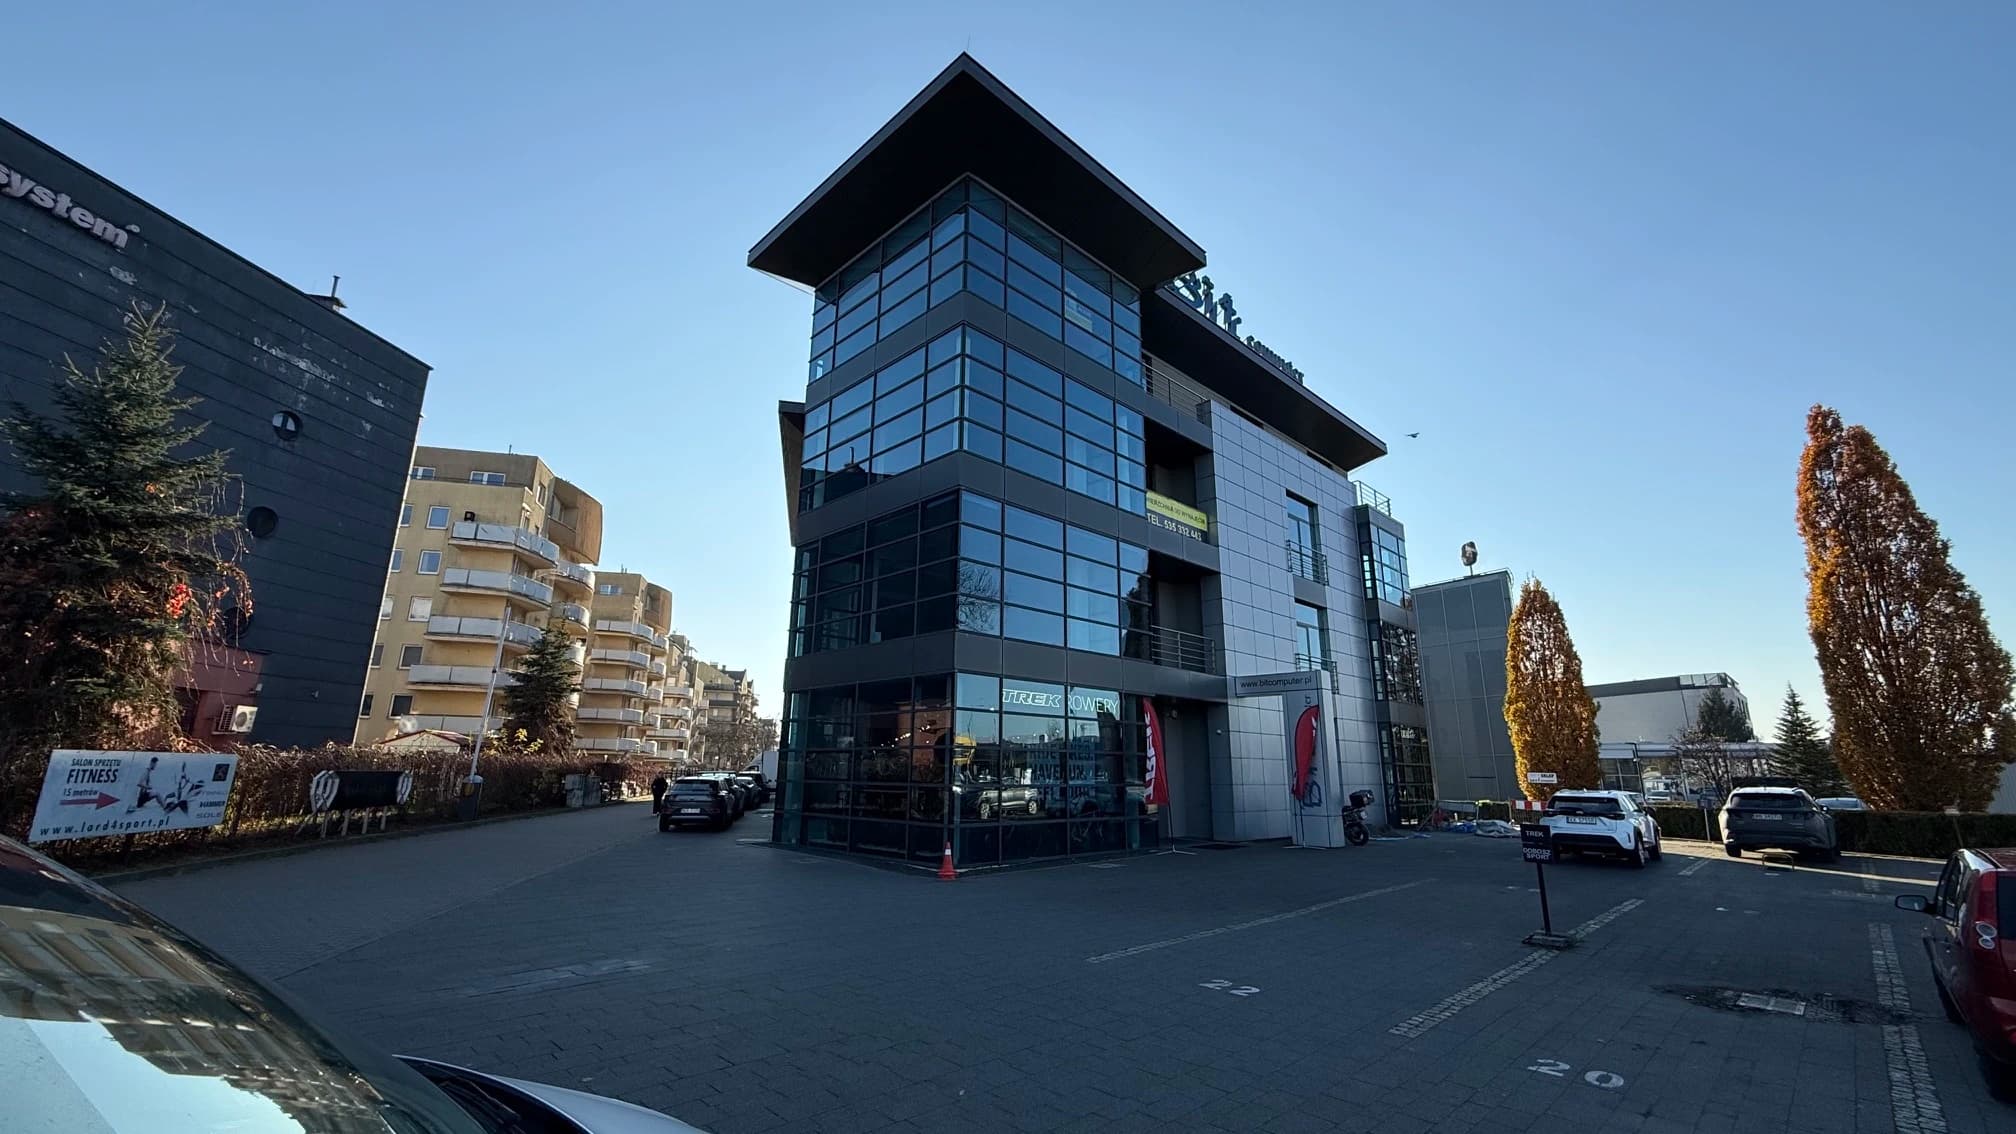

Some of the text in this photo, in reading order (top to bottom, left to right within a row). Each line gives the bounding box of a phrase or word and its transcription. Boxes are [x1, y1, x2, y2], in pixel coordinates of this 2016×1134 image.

[1240, 676, 1312, 688] www.bitcomputer.pl
[1002, 689, 1062, 708] TREK
[71, 758, 93, 767] SALON
[66, 768, 118, 783] FITNESS
[1525, 830, 1544, 838] TREK
[1198, 979, 1260, 996] 22
[1527, 1059, 1624, 1088] 20
